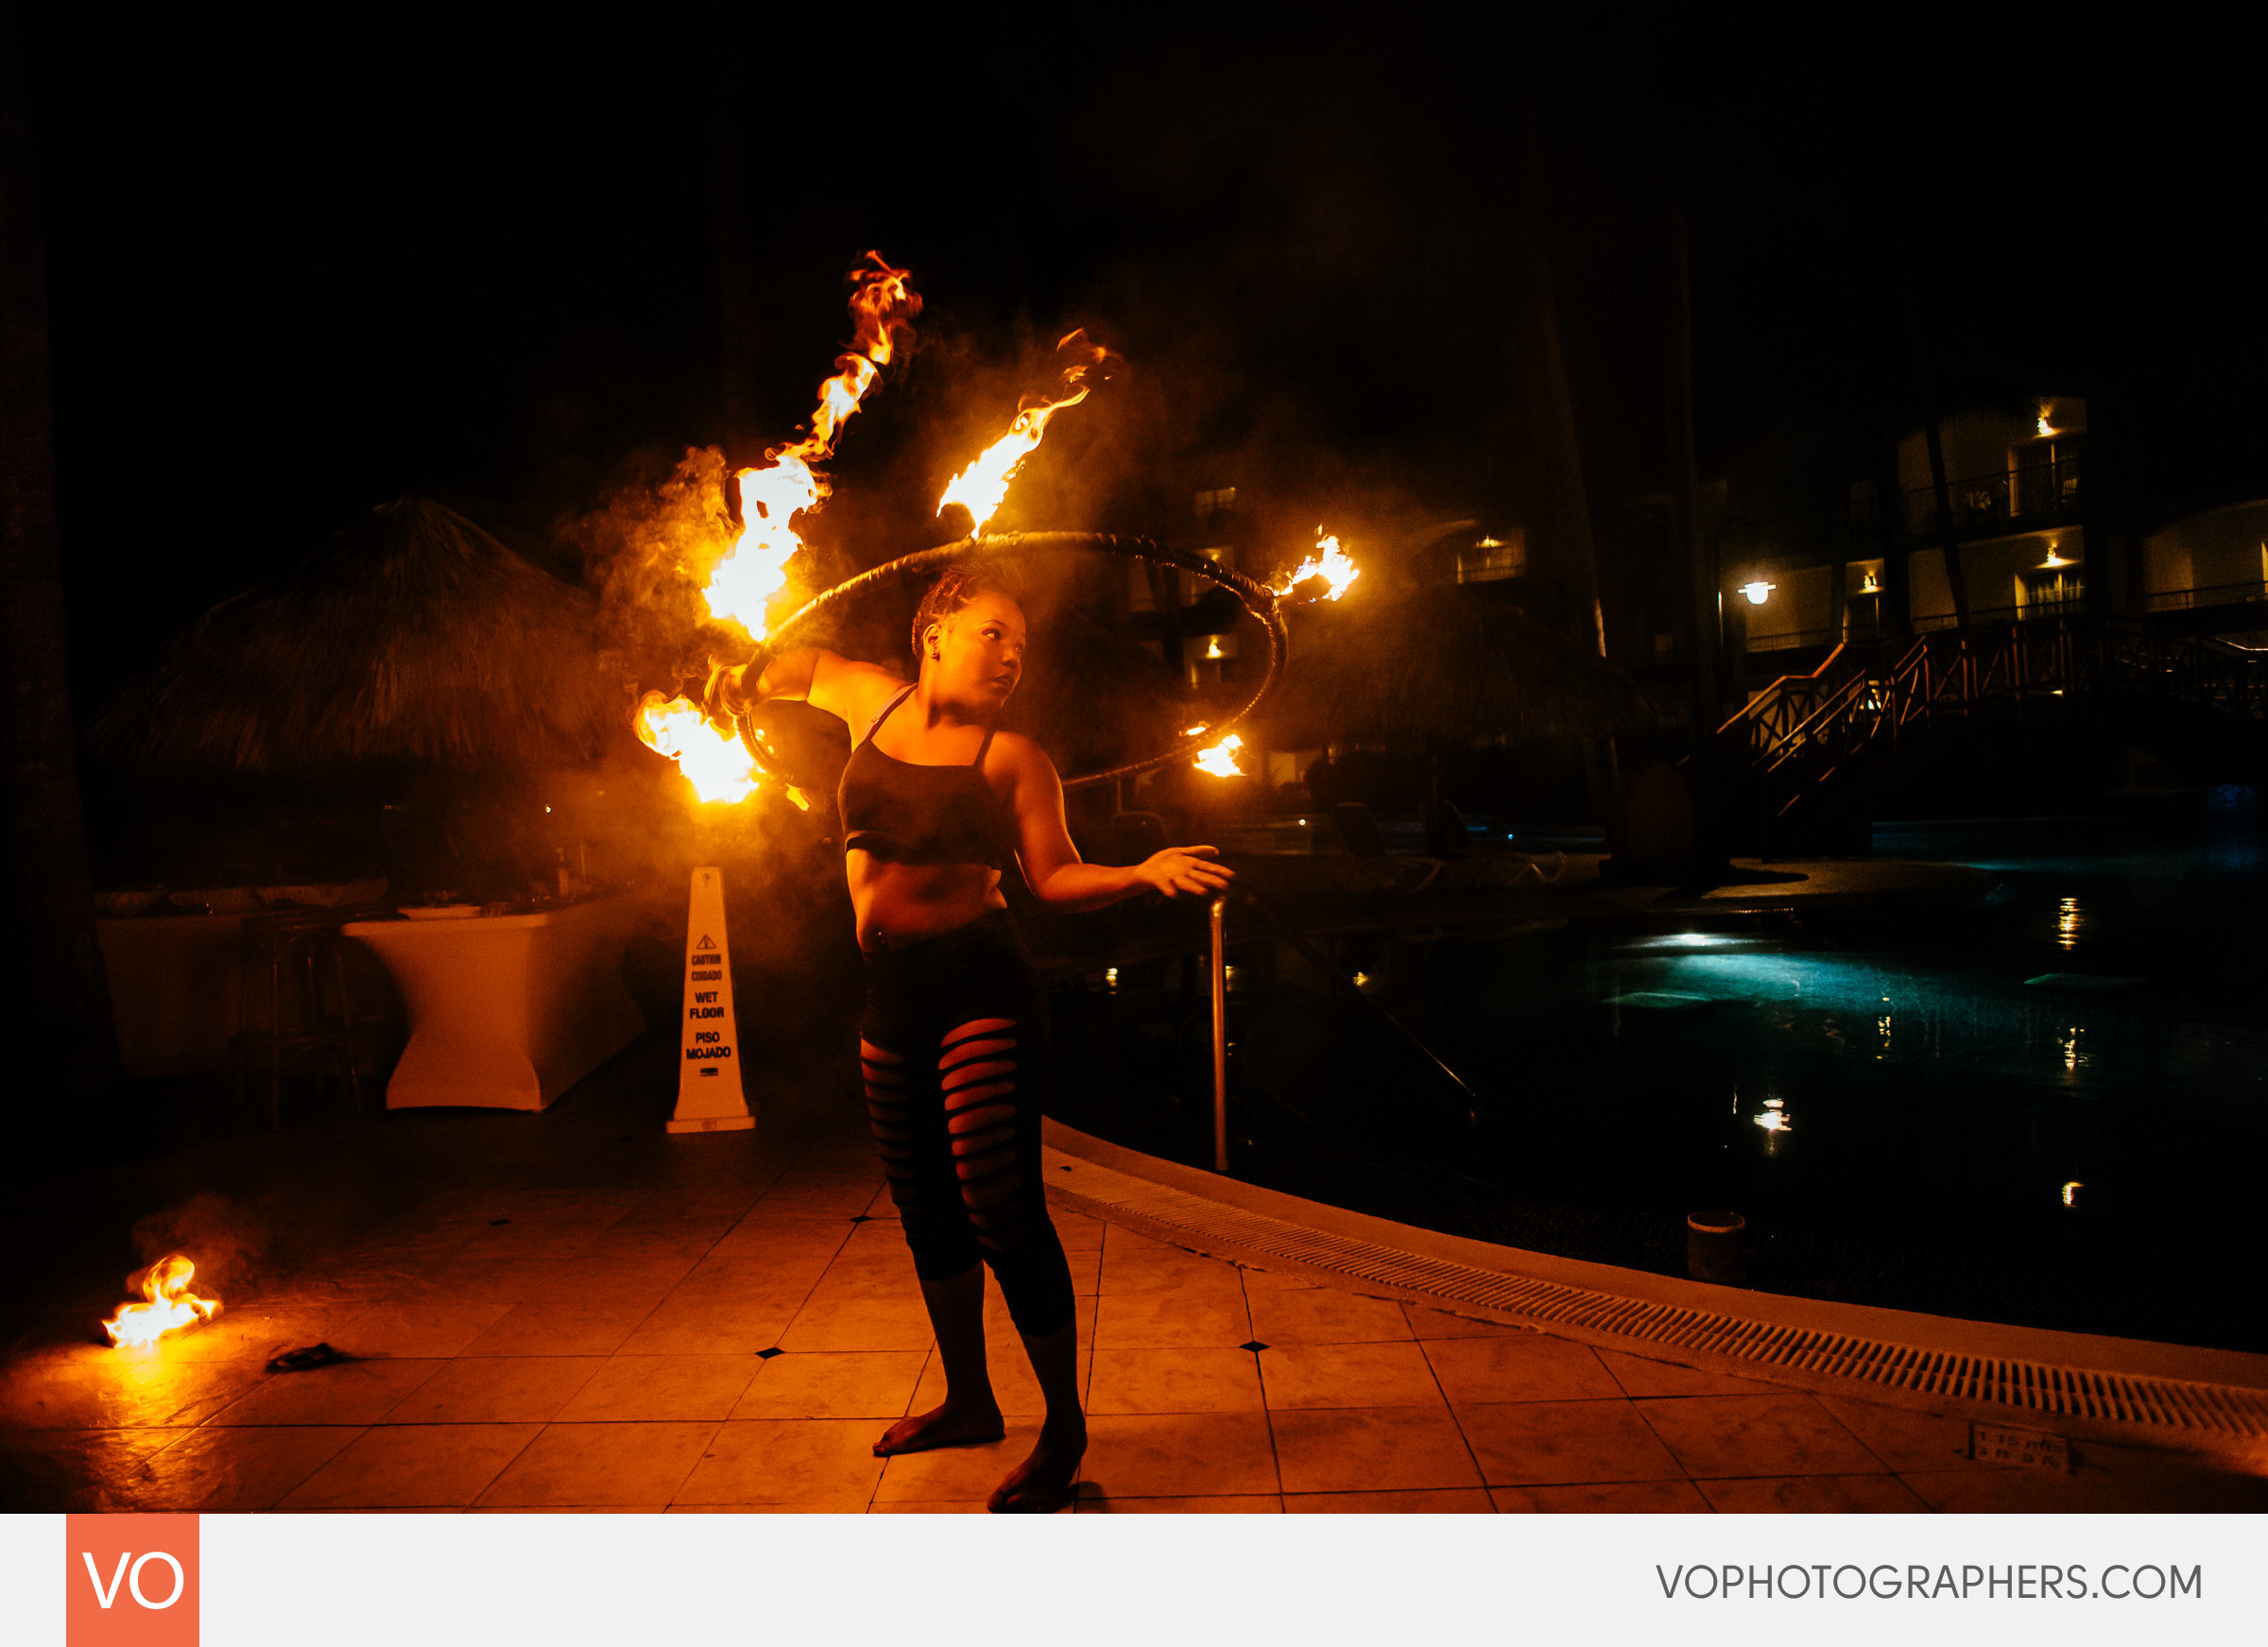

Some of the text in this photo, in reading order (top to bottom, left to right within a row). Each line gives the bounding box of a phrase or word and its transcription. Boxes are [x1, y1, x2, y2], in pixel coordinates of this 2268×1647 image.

[692, 954, 721, 965] CAUTION
[692, 970, 722, 981] CUIDADO
[696, 992, 718, 1003] WET
[690, 1007, 724, 1019] FLOOR
[696, 1032, 720, 1043] PISO
[686, 1047, 731, 1059] MOJADO
